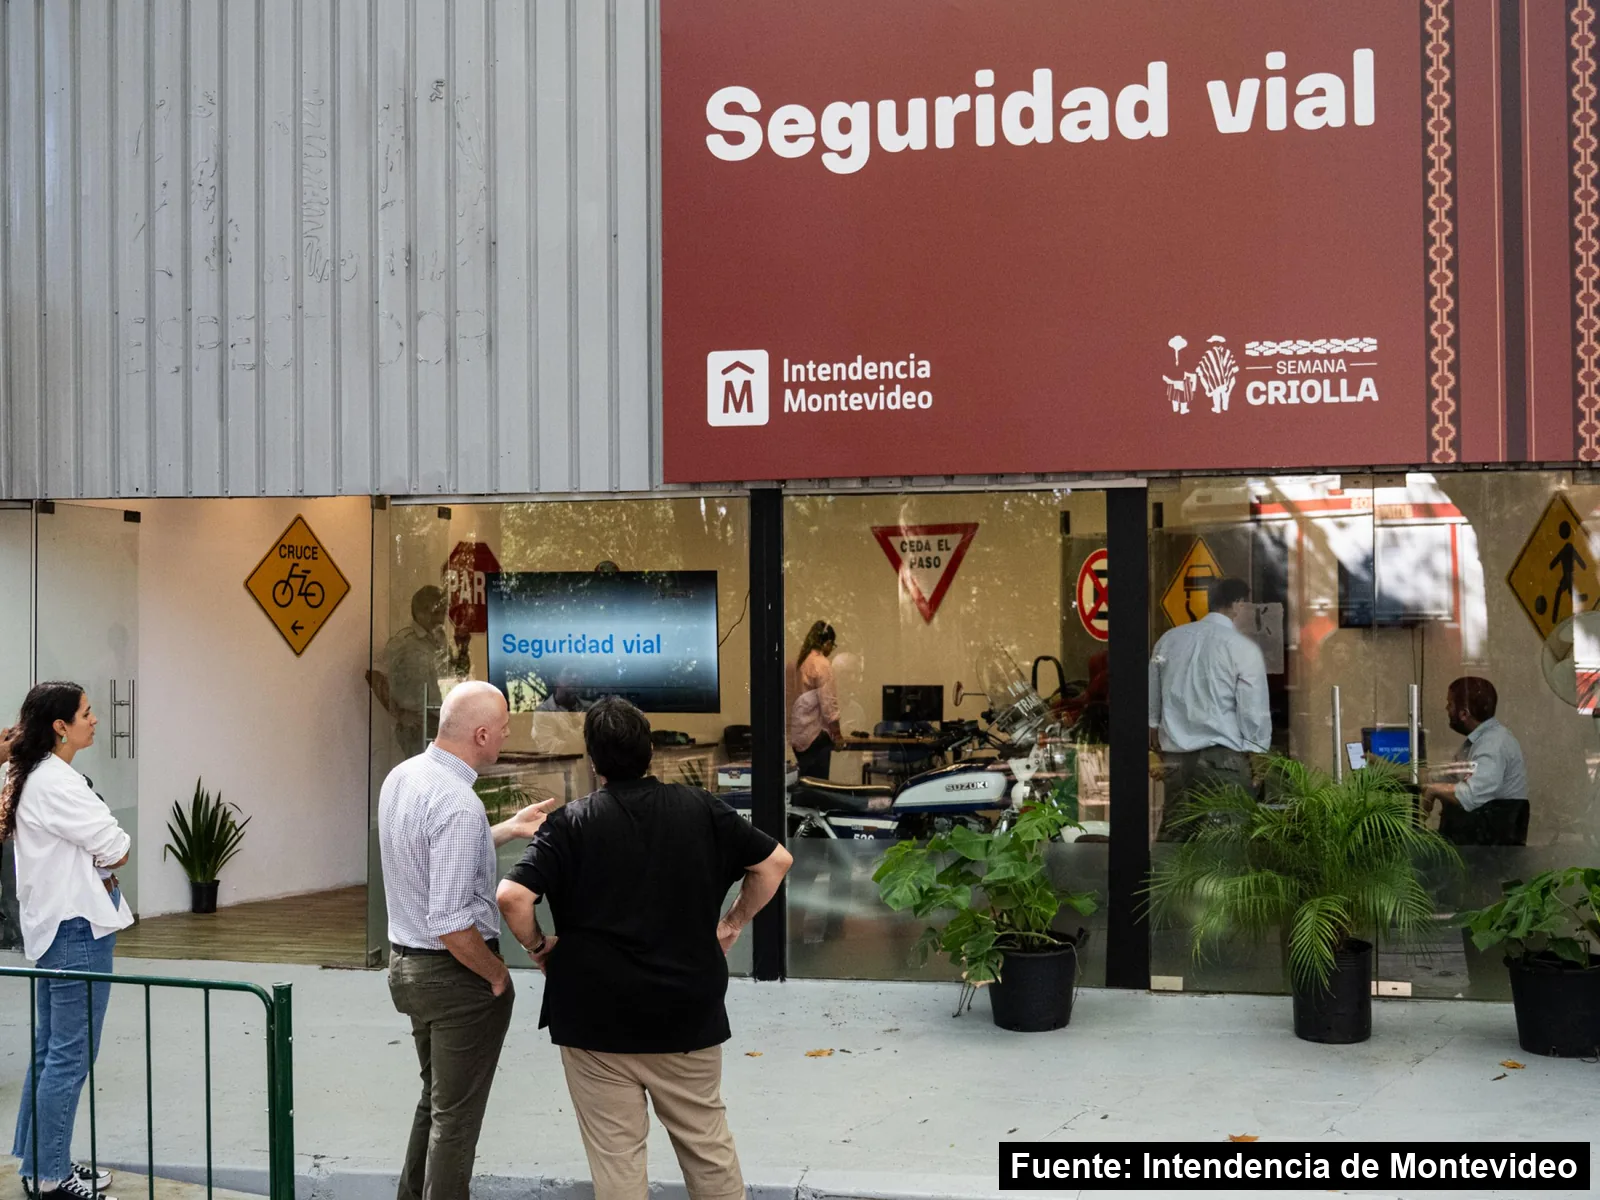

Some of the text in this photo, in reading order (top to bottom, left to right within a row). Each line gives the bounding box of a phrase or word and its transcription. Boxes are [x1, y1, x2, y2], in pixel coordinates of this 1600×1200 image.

[705, 47, 1377, 175] Seguridad vial
[783, 353, 931, 383] Intendencia
[1276, 358, 1348, 375] SEMANA
[783, 384, 934, 413] Montevideo
[1245, 377, 1380, 406] CRIOLLA
[279, 544, 319, 560] CRUCE
[900, 539, 951, 553] CEDA EL
[910, 556, 941, 569] PASO
[447, 569, 486, 605] PAR
[502, 633, 661, 659] Seguridad vial
[945, 781, 989, 792] SUZUKI
